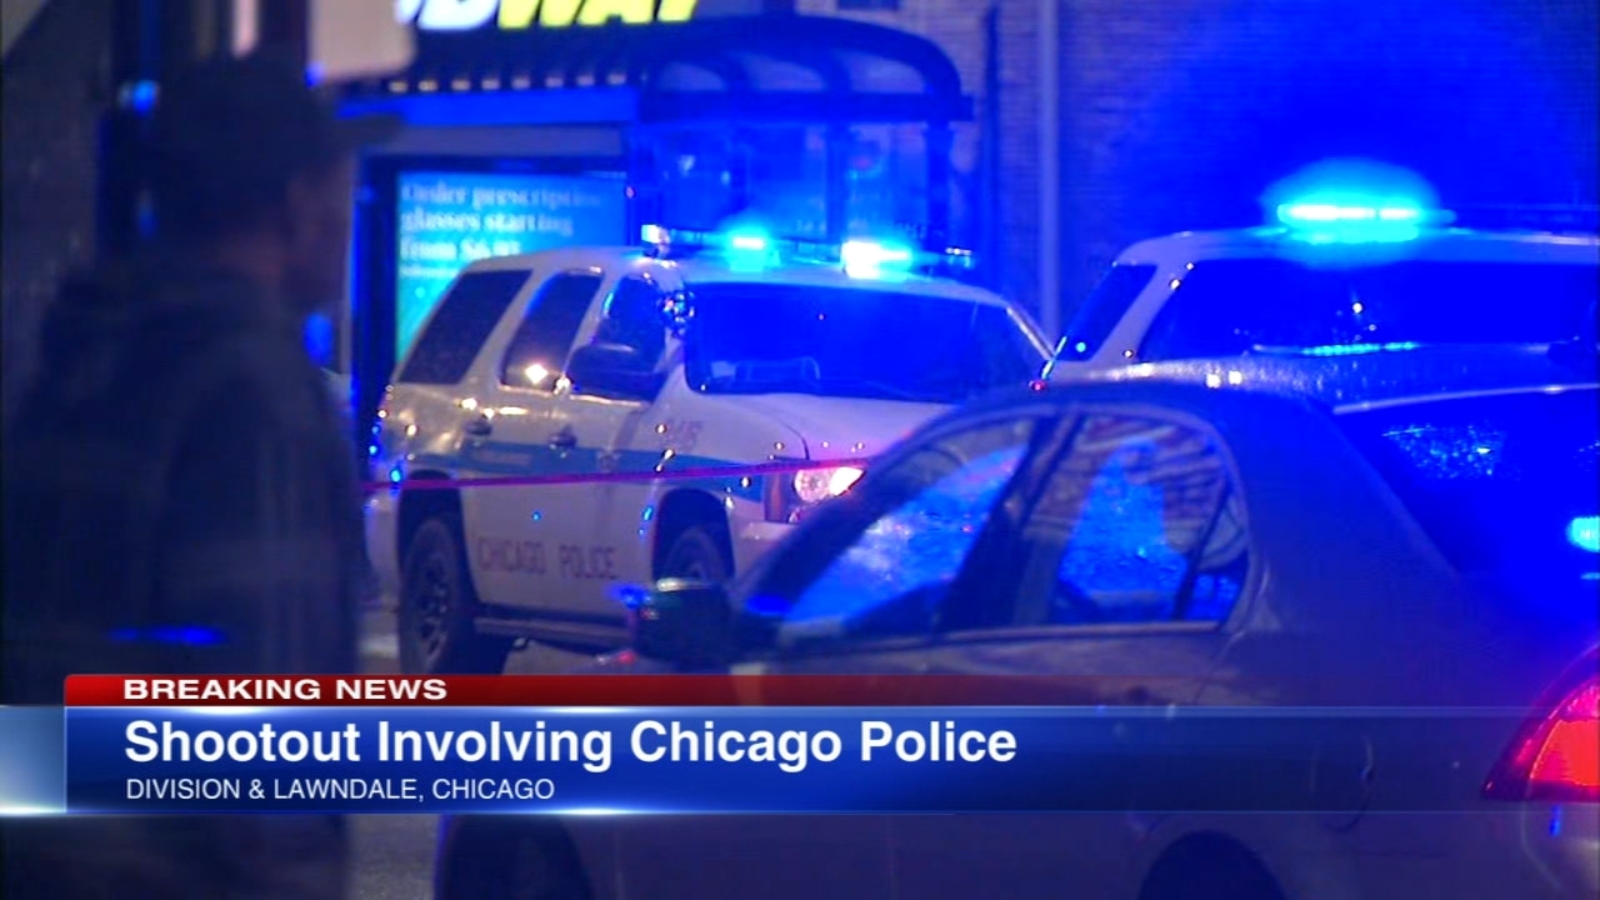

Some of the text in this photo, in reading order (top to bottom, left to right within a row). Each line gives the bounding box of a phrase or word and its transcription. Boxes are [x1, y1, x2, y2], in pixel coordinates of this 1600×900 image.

[401, 206, 574, 239] glasses starting
[478, 537, 618, 580] CHICAGO POLICE
